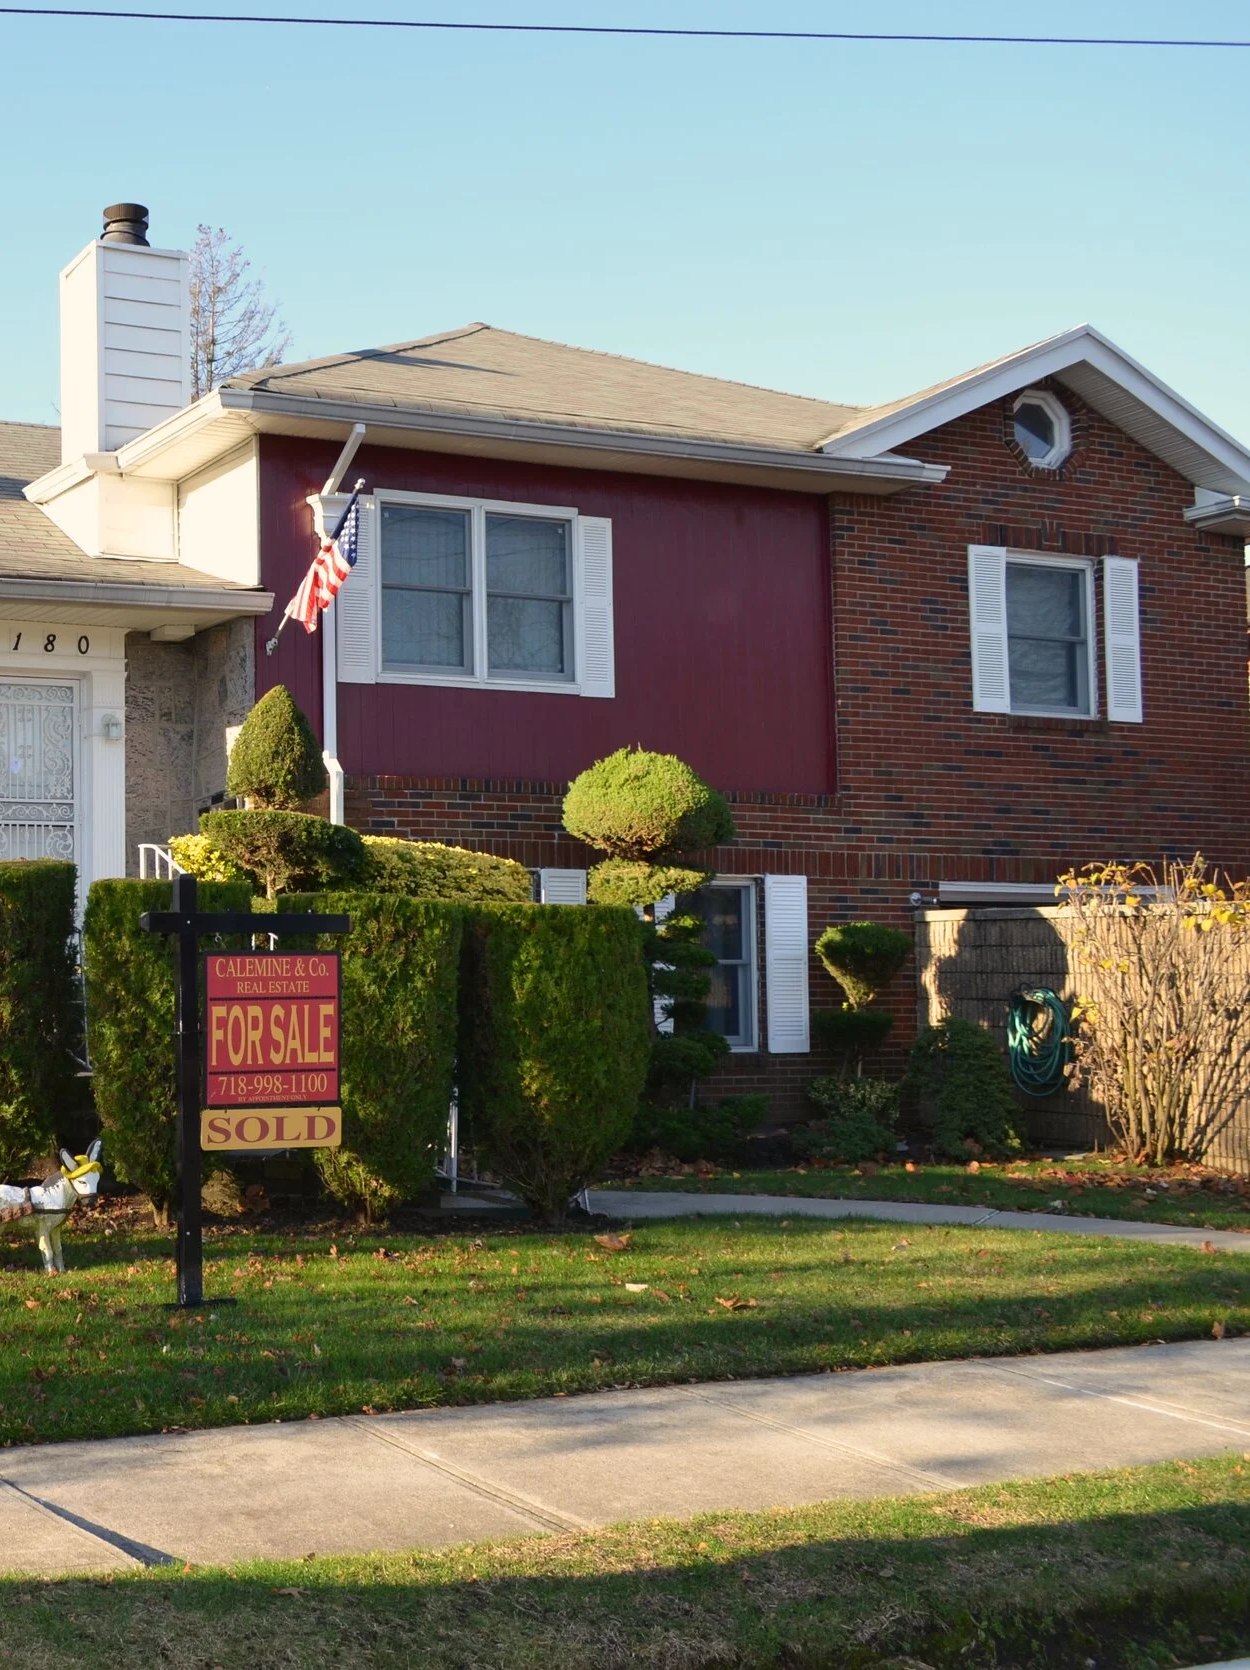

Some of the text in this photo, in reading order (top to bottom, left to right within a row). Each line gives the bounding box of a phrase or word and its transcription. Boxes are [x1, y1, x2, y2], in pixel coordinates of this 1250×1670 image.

[215, 957, 330, 978] CALEMINE & Co.
[236, 980, 310, 994] REAL ESTATE
[211, 1003, 335, 1066] FOR SALE
[218, 1073, 328, 1096] 718-998-1100
[207, 1115, 336, 1144] SOLD
